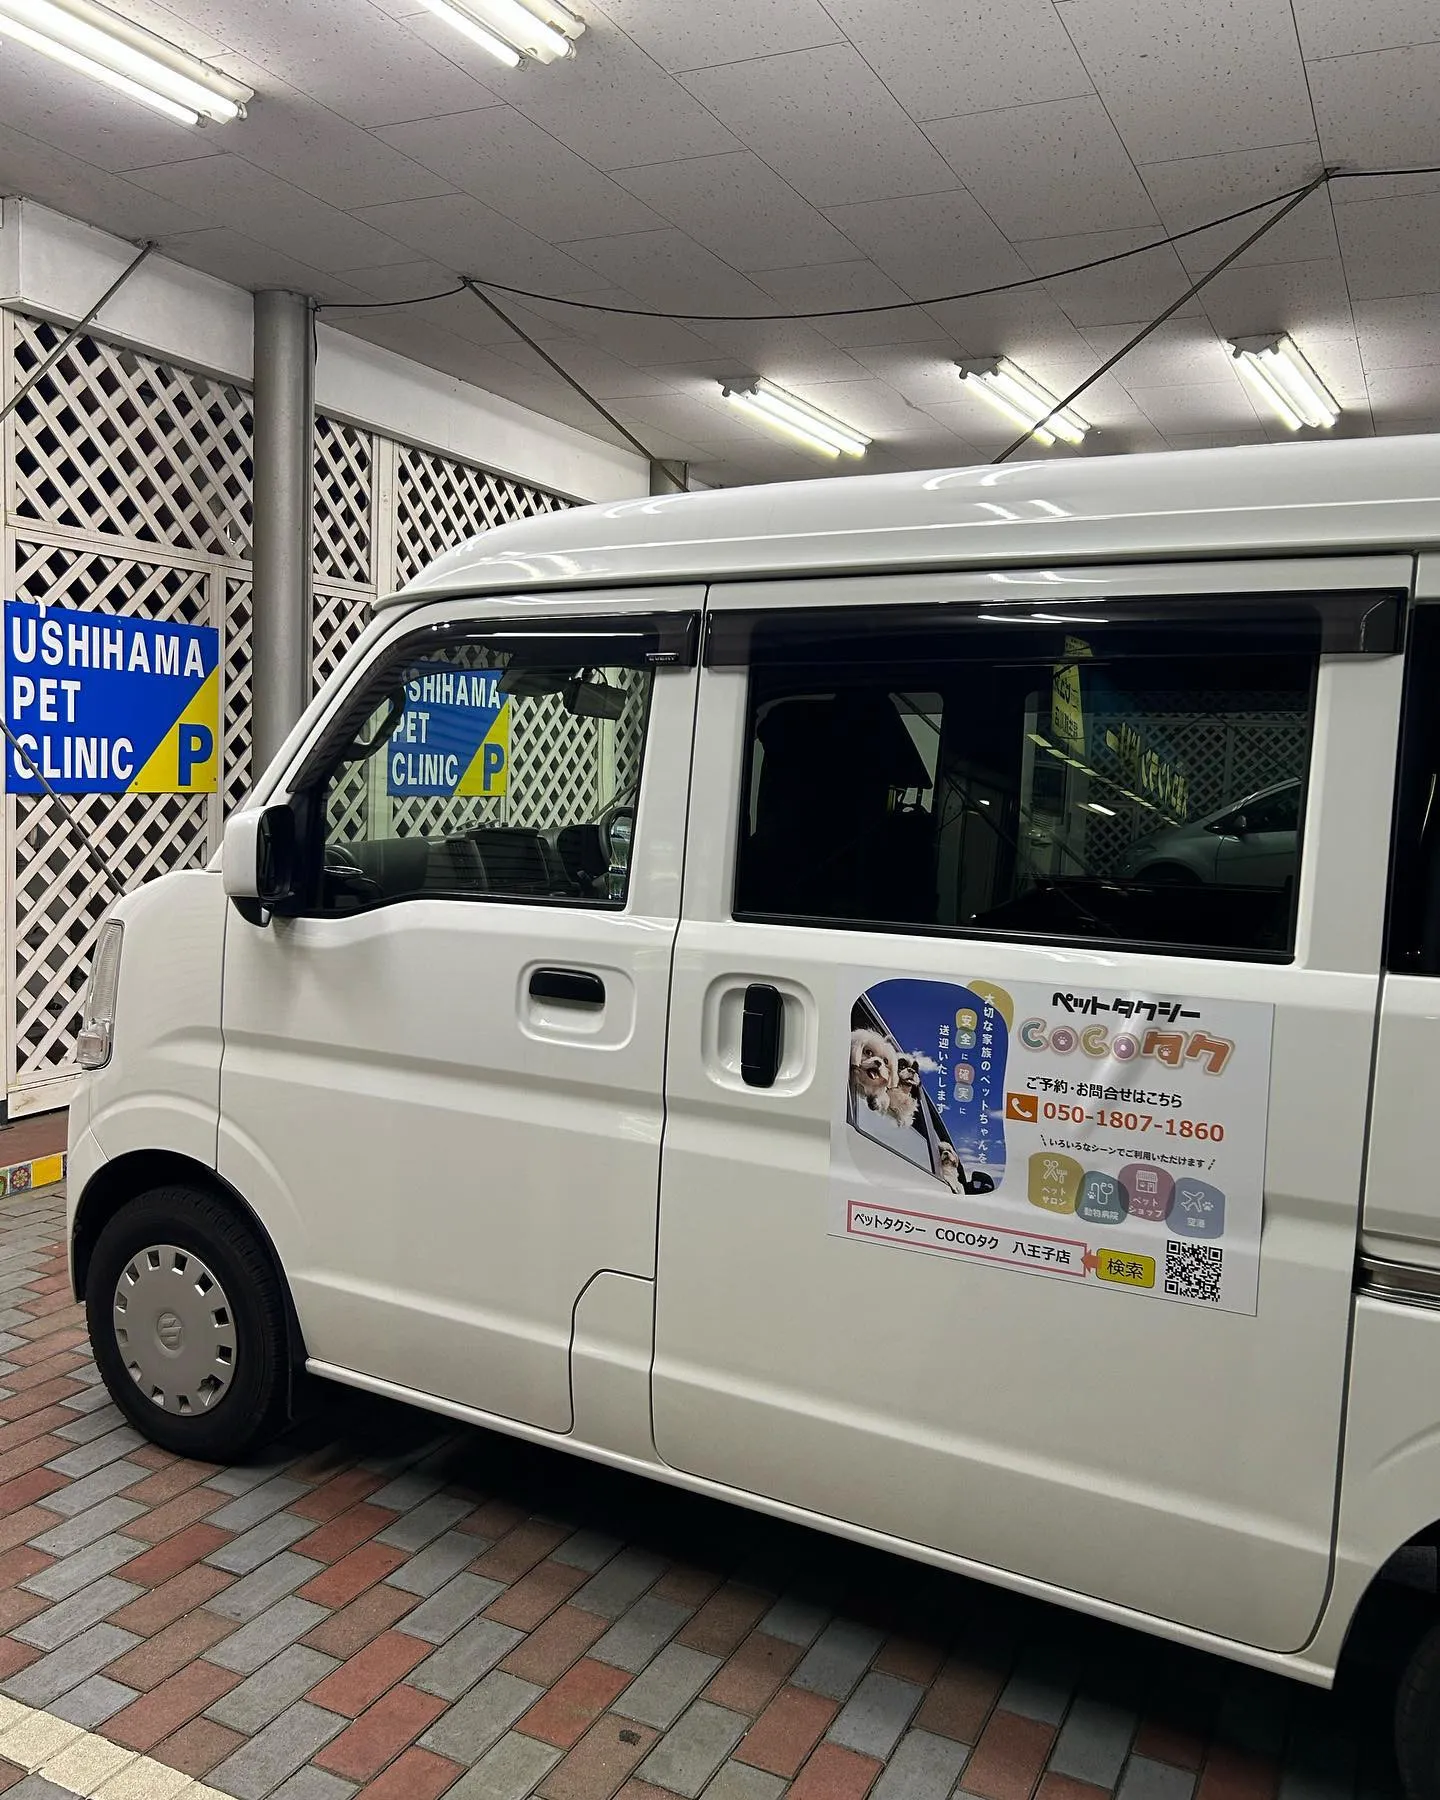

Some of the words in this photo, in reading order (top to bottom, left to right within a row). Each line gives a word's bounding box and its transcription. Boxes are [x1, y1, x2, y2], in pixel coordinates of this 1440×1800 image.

[12, 616, 205, 678] USHIHAMA
[13, 676, 81, 723] PET
[403, 672, 501, 709] SHIHAMA
[13, 733, 134, 781] CLINIC
[177, 723, 214, 787] P
[392, 752, 459, 786] CLINIC
[483, 743, 505, 791] P
[1052, 991, 1201, 1023] ペットタクシー
[935, 1024, 950, 1115] 送迎いたします
[958, 1013, 972, 1116] 安全に確実に
[977, 993, 995, 1165] 大切な家族のペットちゃんを
[1043, 1102, 1224, 1143] 050-1807-1860
[1048, 1137, 1206, 1169] いろいろなシーンでご利用いただけます
[1040, 1185, 1067, 1197] ペット
[1041, 1195, 1067, 1206] サロン
[1131, 1195, 1160, 1207] ペット
[853, 1212, 927, 1236] ペットタクシー
[934, 1228, 1000, 1251] COCOタク
[1012, 1241, 1071, 1265] 八王子店
[1106, 1257, 1144, 1280] 検索
